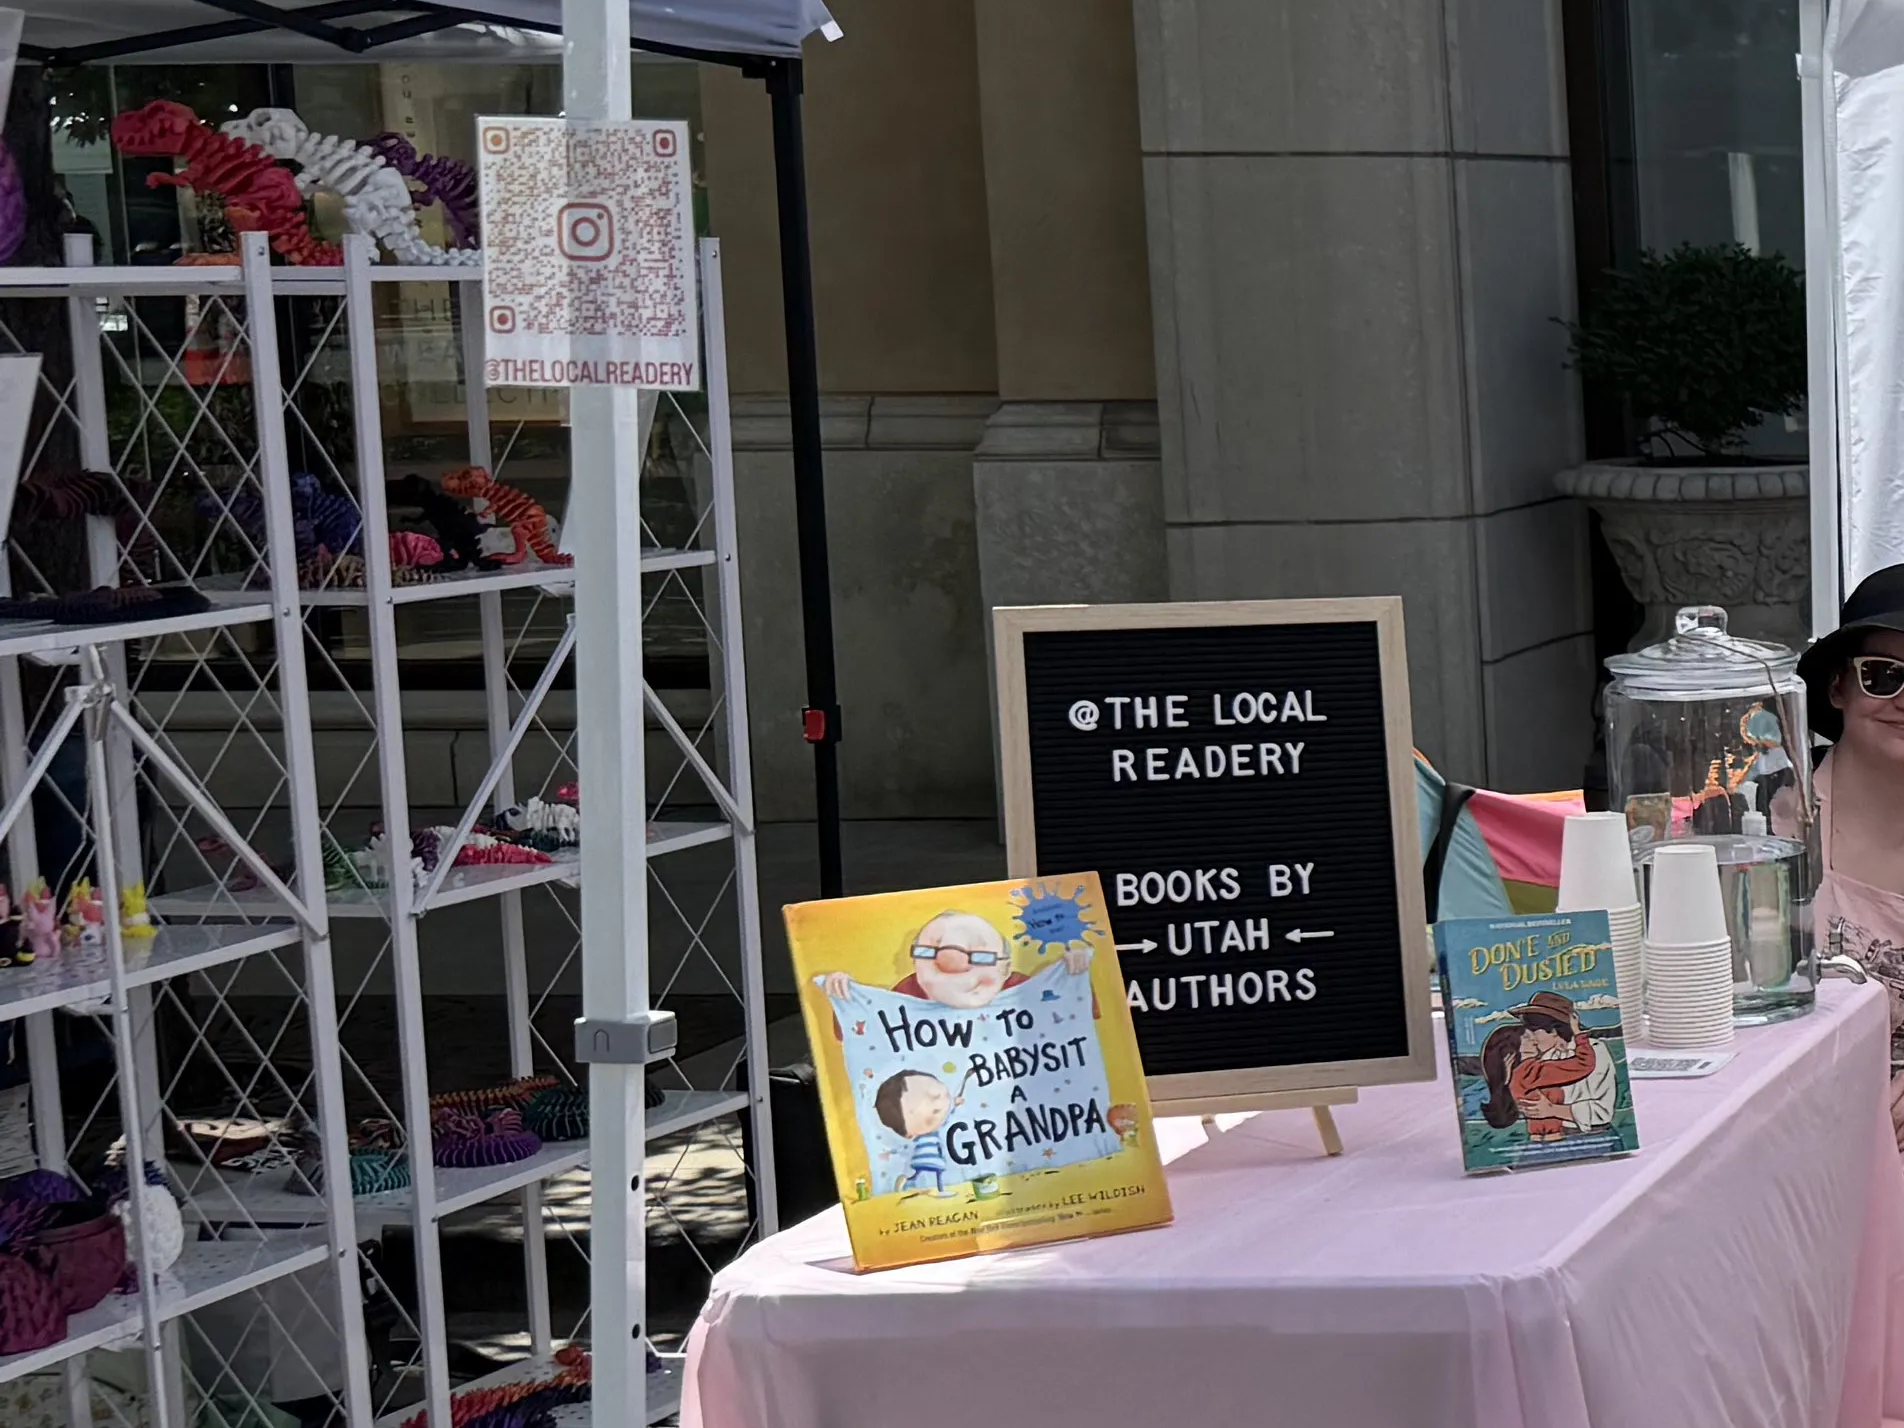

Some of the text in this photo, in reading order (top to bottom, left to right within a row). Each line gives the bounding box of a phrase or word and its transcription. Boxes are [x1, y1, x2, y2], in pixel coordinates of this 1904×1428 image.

[485, 359, 693, 386] @THELOCALREADERY
[1214, 689, 1327, 727] LOCAL
[1113, 742, 1304, 782] READERY
[1117, 862, 1314, 907] BOOKS BY
[1167, 918, 1270, 956] UTAH
[1127, 968, 1316, 1013] AUTHORS
[1499, 949, 1597, 991] DUSTED
[969, 1036, 1087, 1087] BABYSIT
[1011, 1085, 1028, 1103] A
[946, 1098, 1106, 1166] GRANDPA
[893, 1217, 926, 1234] JEAN
[1061, 1194, 1085, 1207] LEE
[1088, 1185, 1145, 1202] WILDISH
